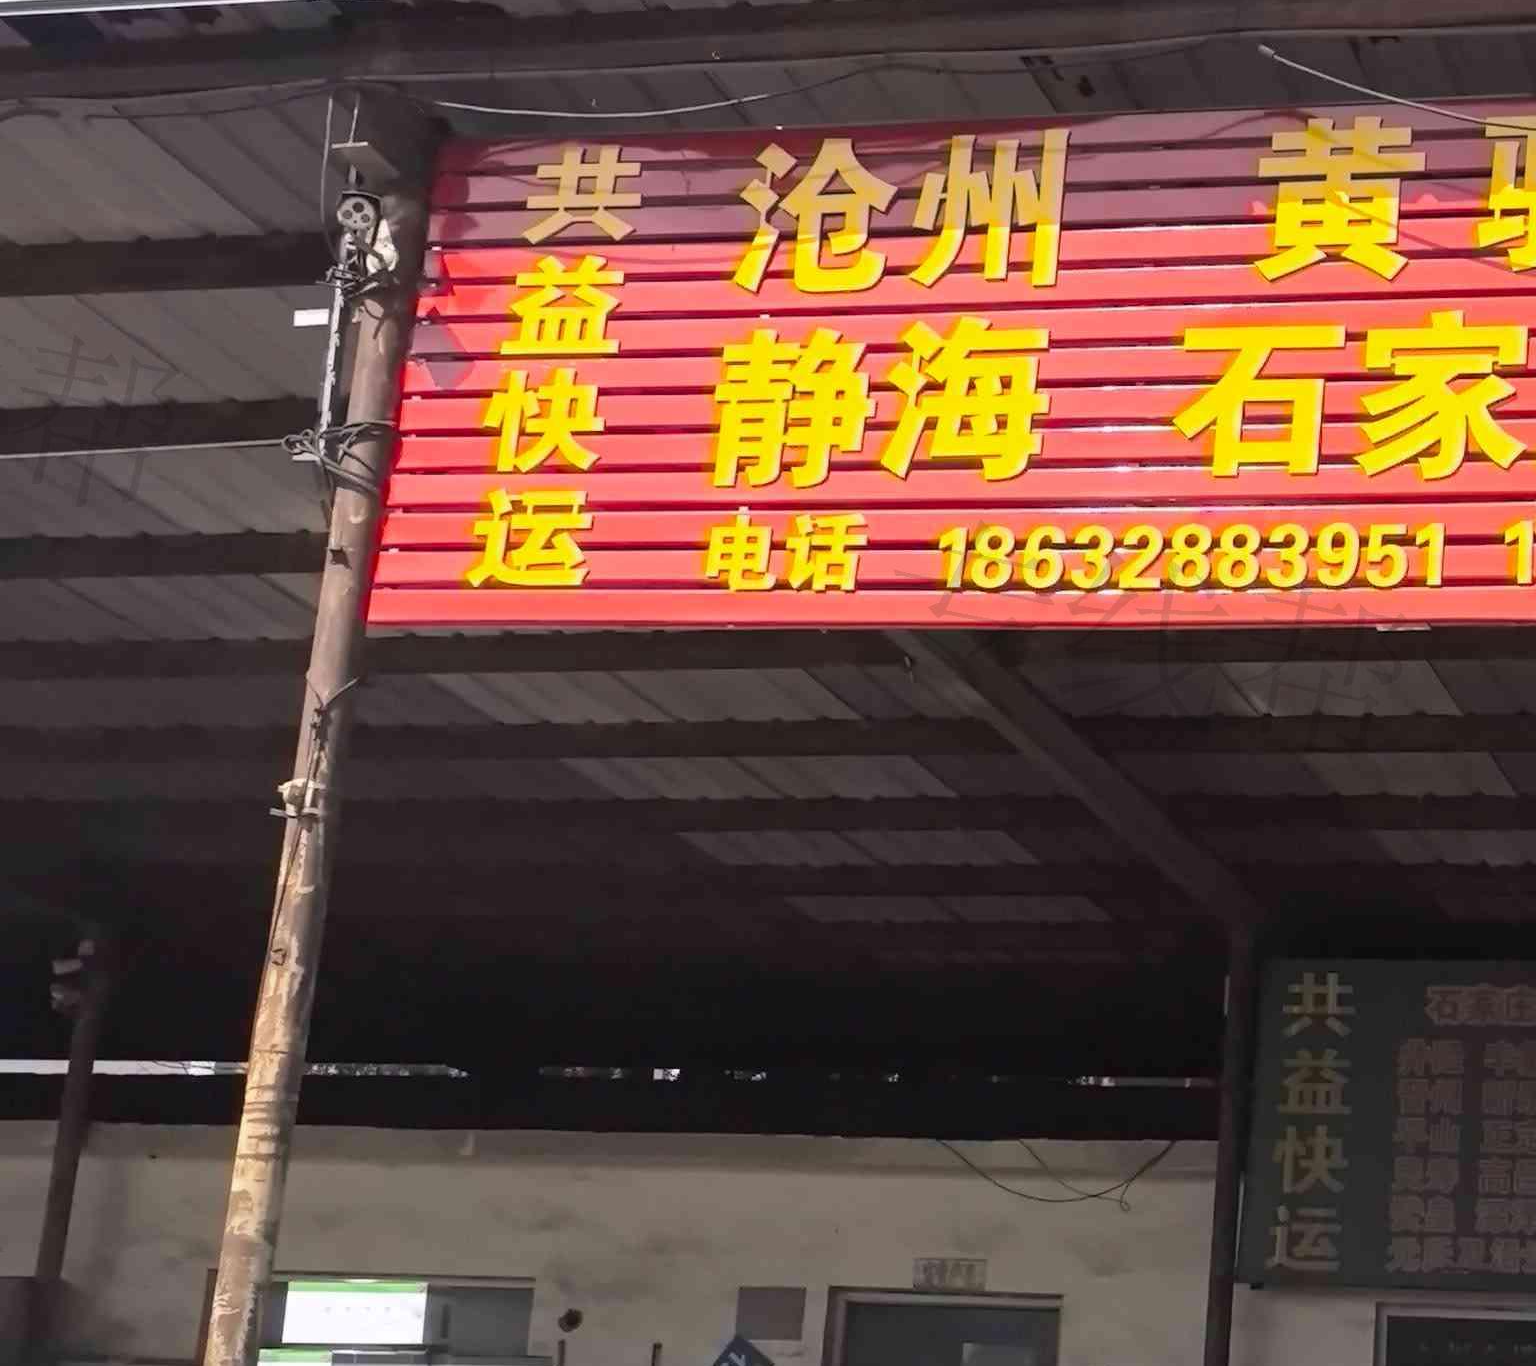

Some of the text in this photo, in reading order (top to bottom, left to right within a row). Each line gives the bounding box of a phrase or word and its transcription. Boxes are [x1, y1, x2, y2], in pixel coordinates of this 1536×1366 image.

[728, 128, 1068, 293] 沧州
[463, 145, 641, 590] 共益快运
[708, 313, 1050, 490] 静海
[699, 512, 867, 593] 电话
[935, 520, 1446, 594] 18632883951
[1266, 972, 1356, 1272] 共益快运
